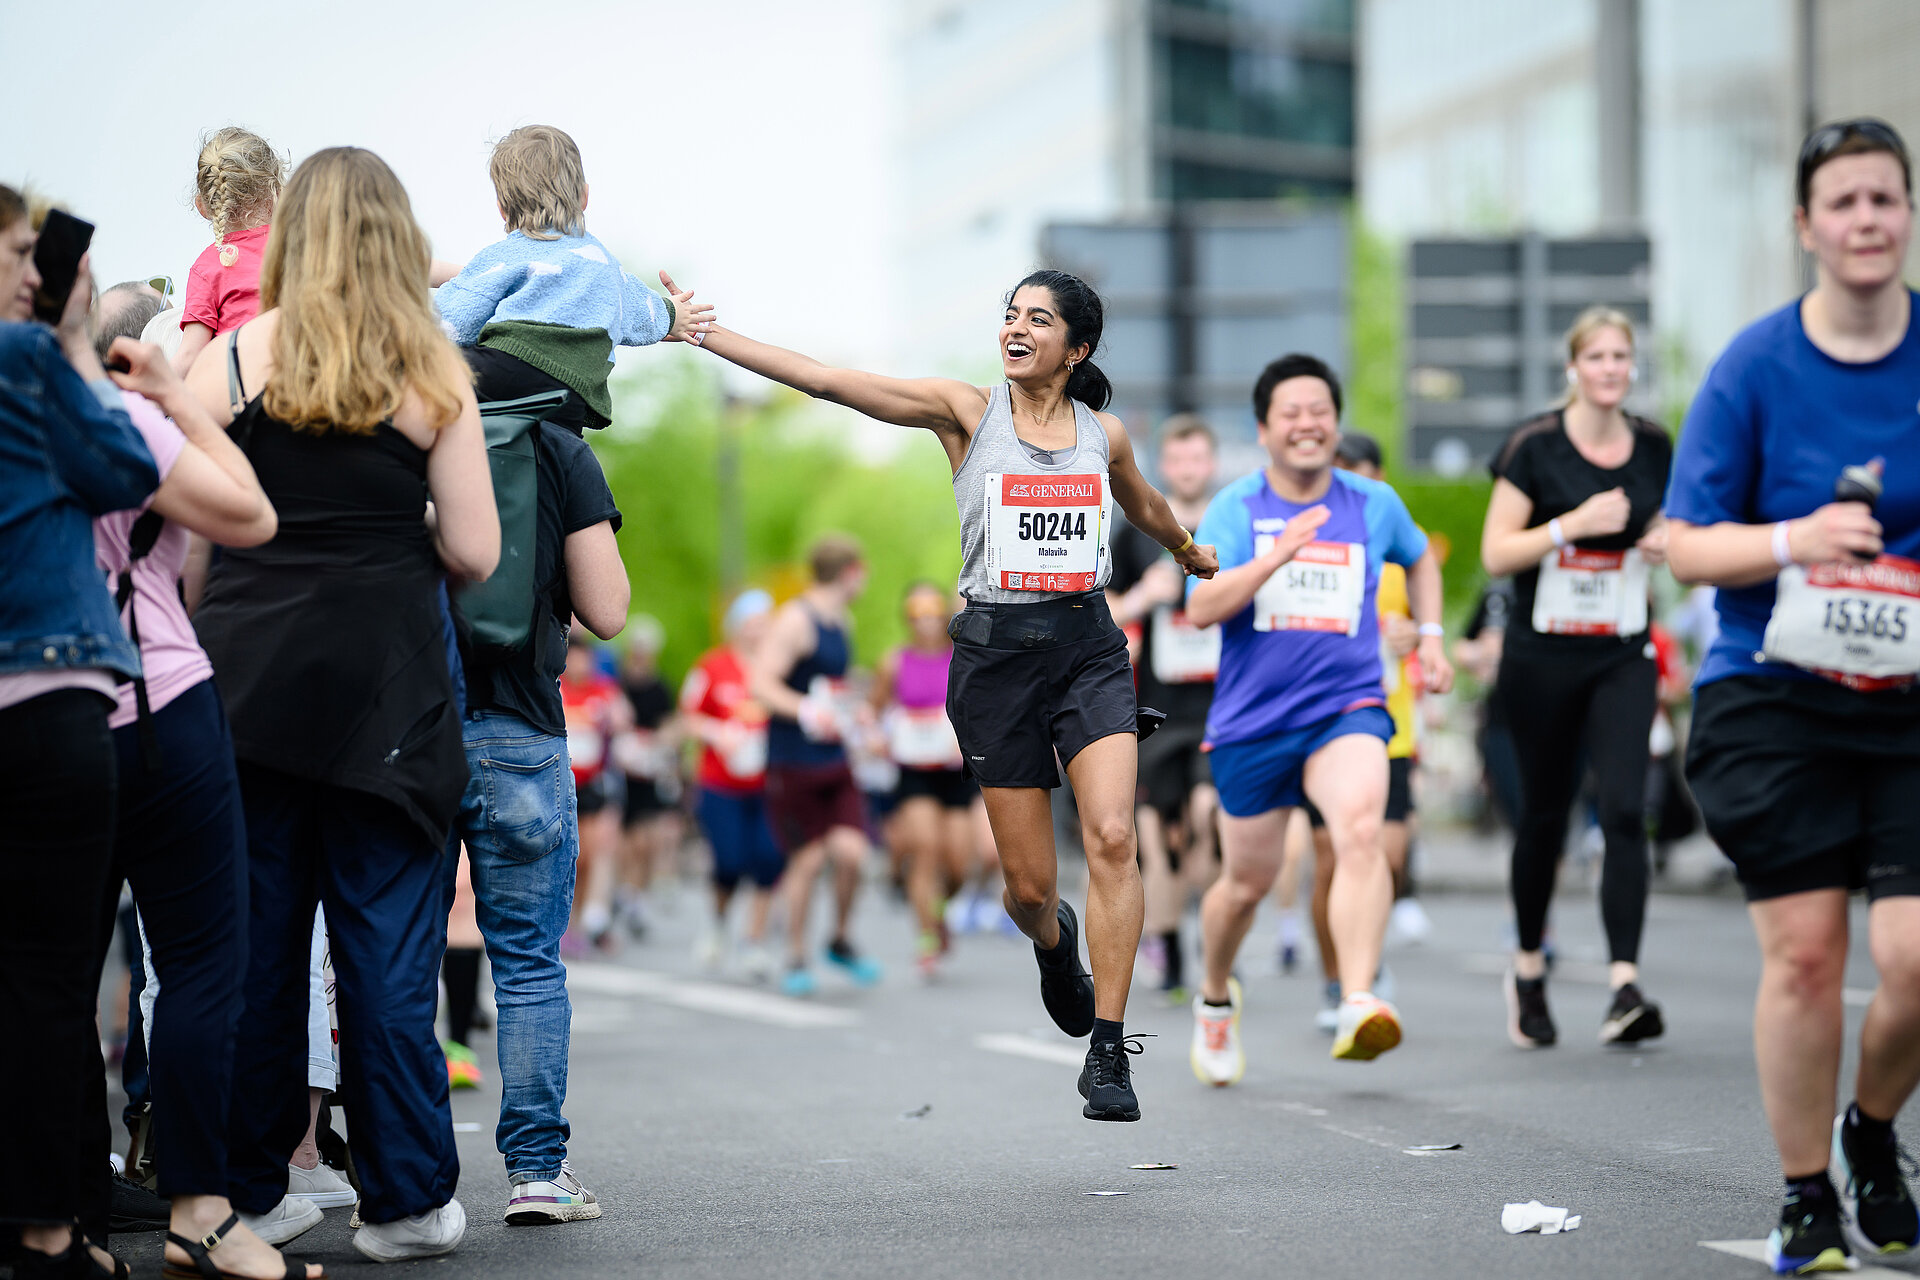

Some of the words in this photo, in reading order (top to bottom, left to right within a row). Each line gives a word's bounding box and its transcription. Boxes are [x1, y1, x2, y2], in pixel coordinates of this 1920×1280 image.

[1030, 484, 1093, 497] GENERALI
[1018, 512, 1087, 541] 50244
[1038, 547, 1068, 557] Malavika
[1823, 599, 1909, 642] 15365
